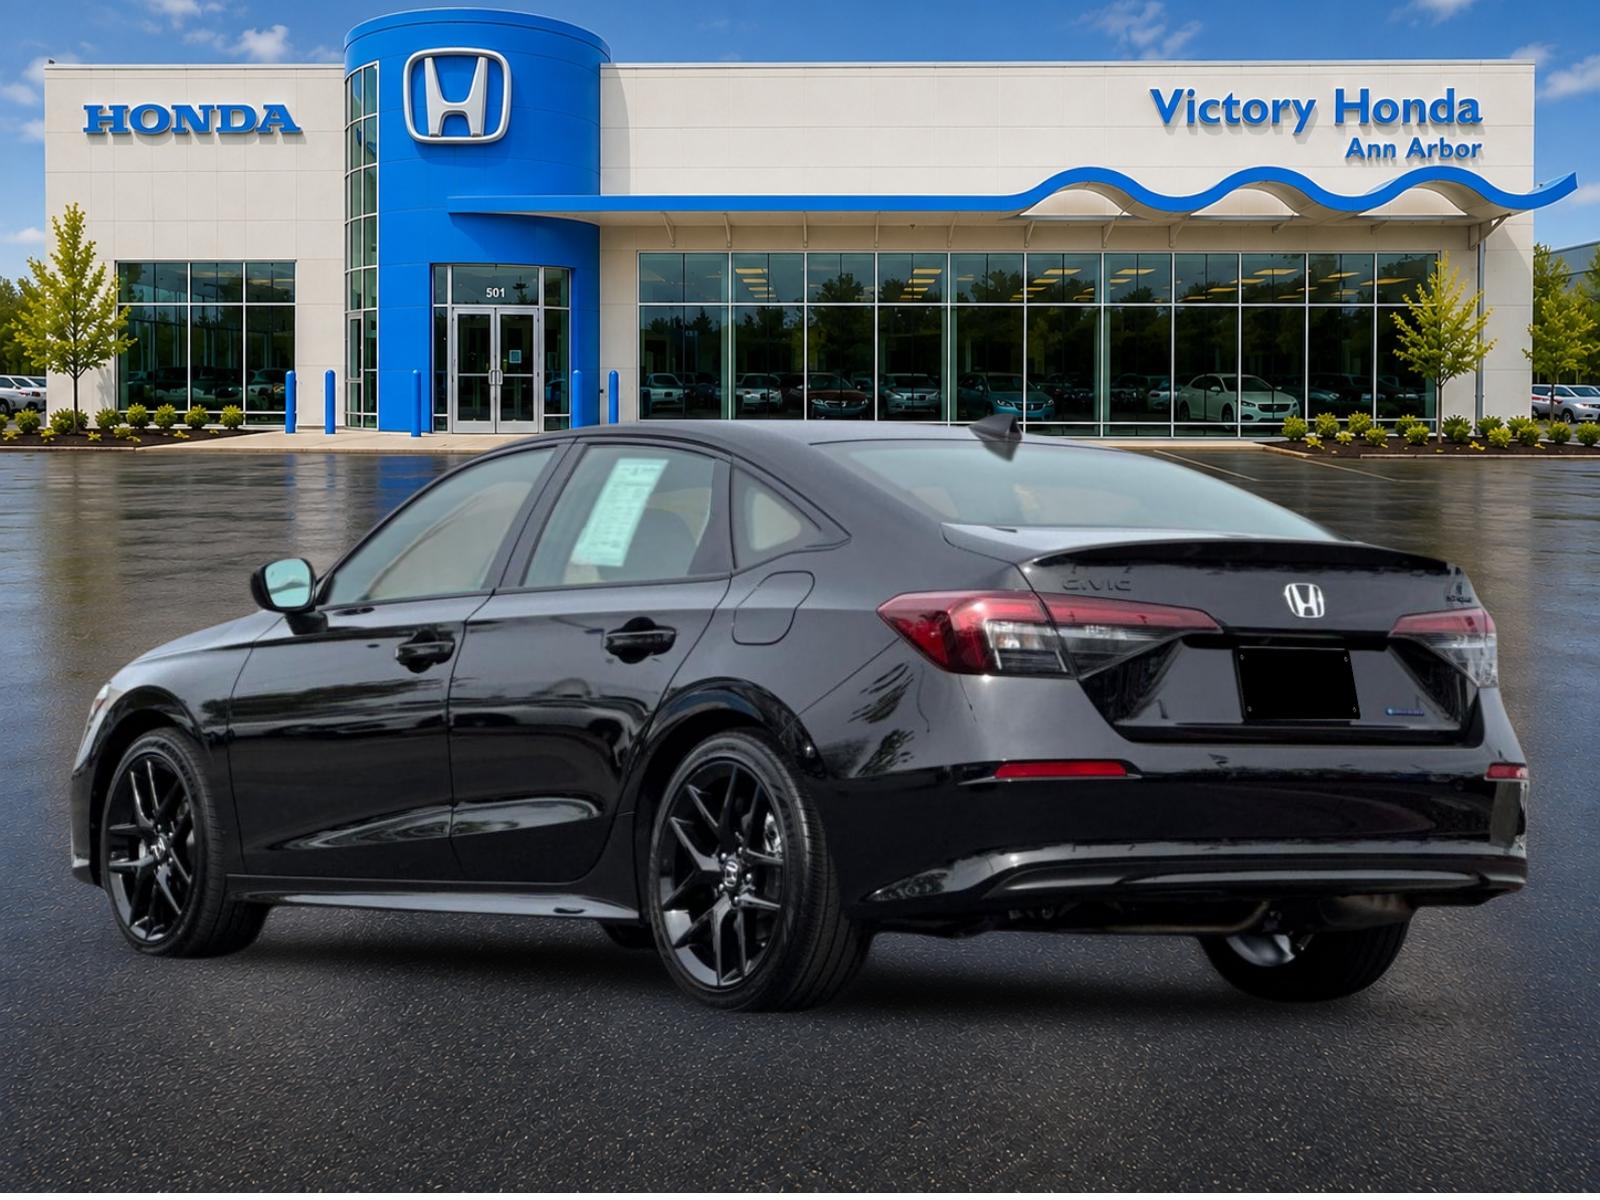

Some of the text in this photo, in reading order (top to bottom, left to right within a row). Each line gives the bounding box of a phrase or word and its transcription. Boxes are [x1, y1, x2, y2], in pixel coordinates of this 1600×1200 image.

[83, 103, 302, 136] HONDA
[1151, 88, 1483, 135] Victory Honda
[1346, 137, 1482, 160] Ann Arbor
[485, 287, 506, 298] 501
[1062, 579, 1133, 592] CIVIC
